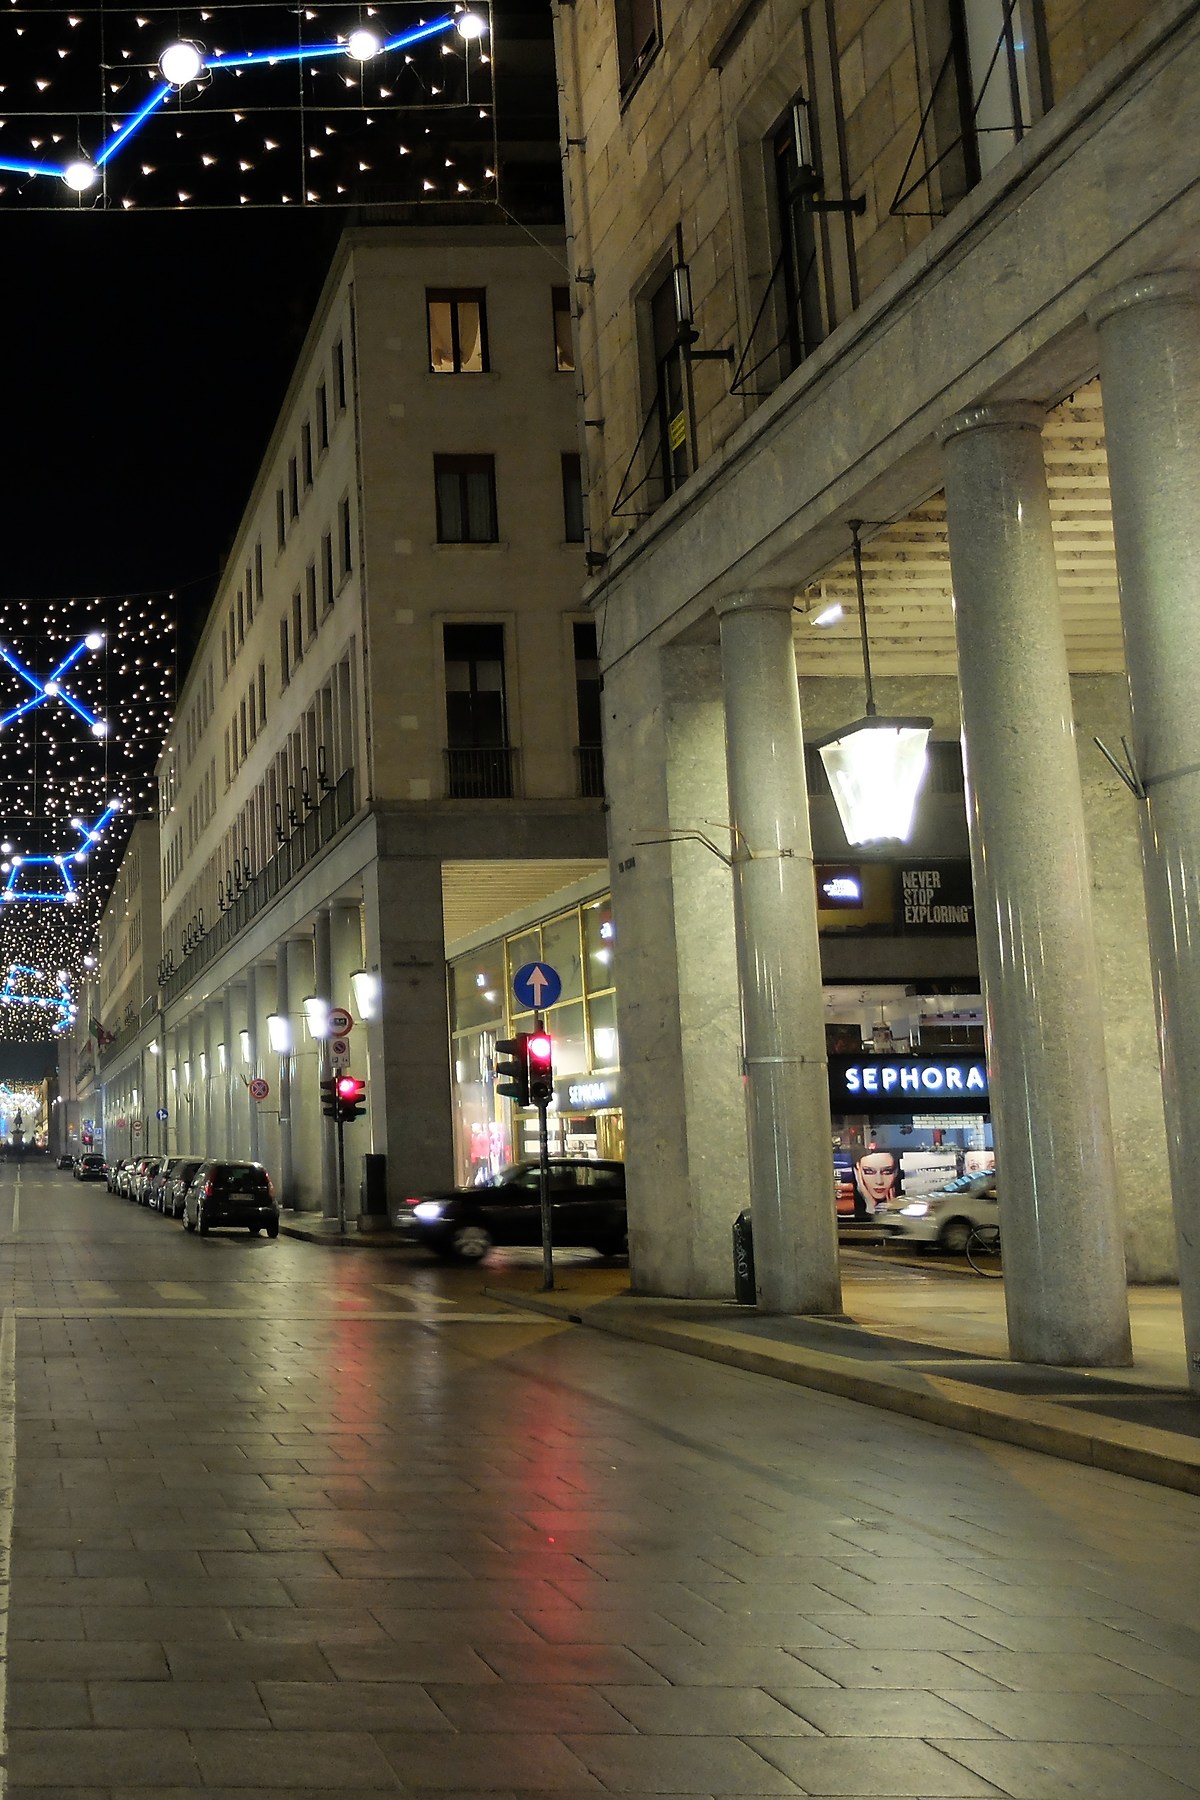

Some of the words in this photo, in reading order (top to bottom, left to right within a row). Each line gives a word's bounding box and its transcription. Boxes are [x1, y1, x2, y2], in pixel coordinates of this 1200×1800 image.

[902, 871, 942, 889] NEVER
[903, 888, 935, 906] STOP
[845, 1067, 984, 1090] SEPHORA
